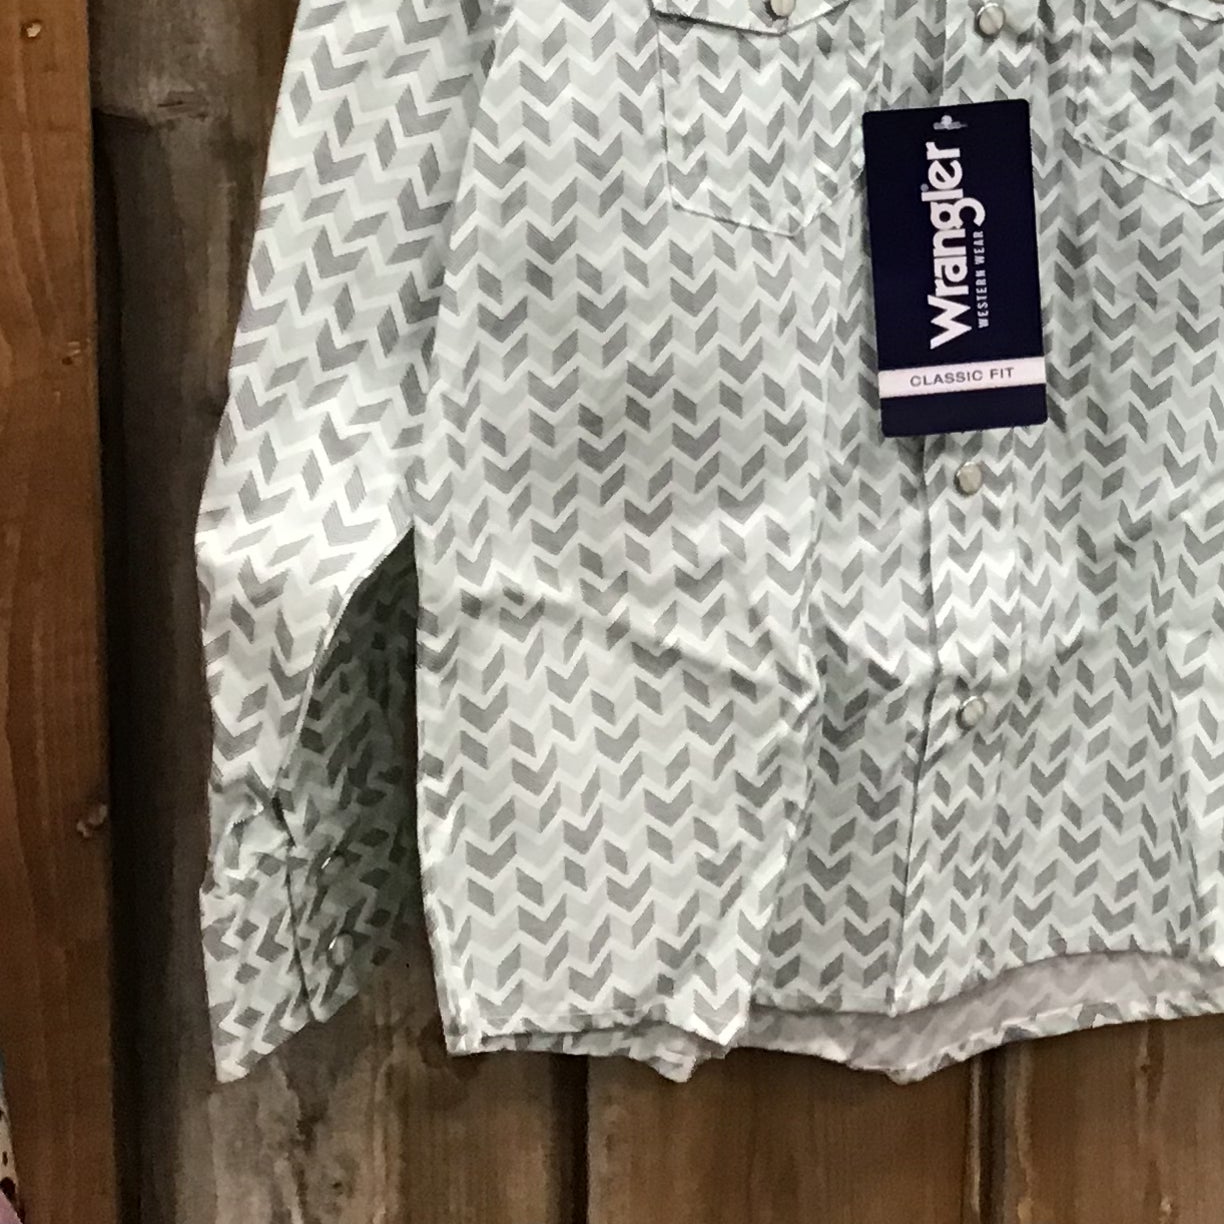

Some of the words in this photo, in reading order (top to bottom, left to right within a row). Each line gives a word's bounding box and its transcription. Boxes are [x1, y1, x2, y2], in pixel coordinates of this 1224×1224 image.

[921, 142, 985, 350] Wrangler
[972, 231, 986, 265] WEAR
[975, 269, 989, 329] WESTERN
[910, 370, 983, 387] CLASSIC
[990, 367, 1014, 380] FIT
